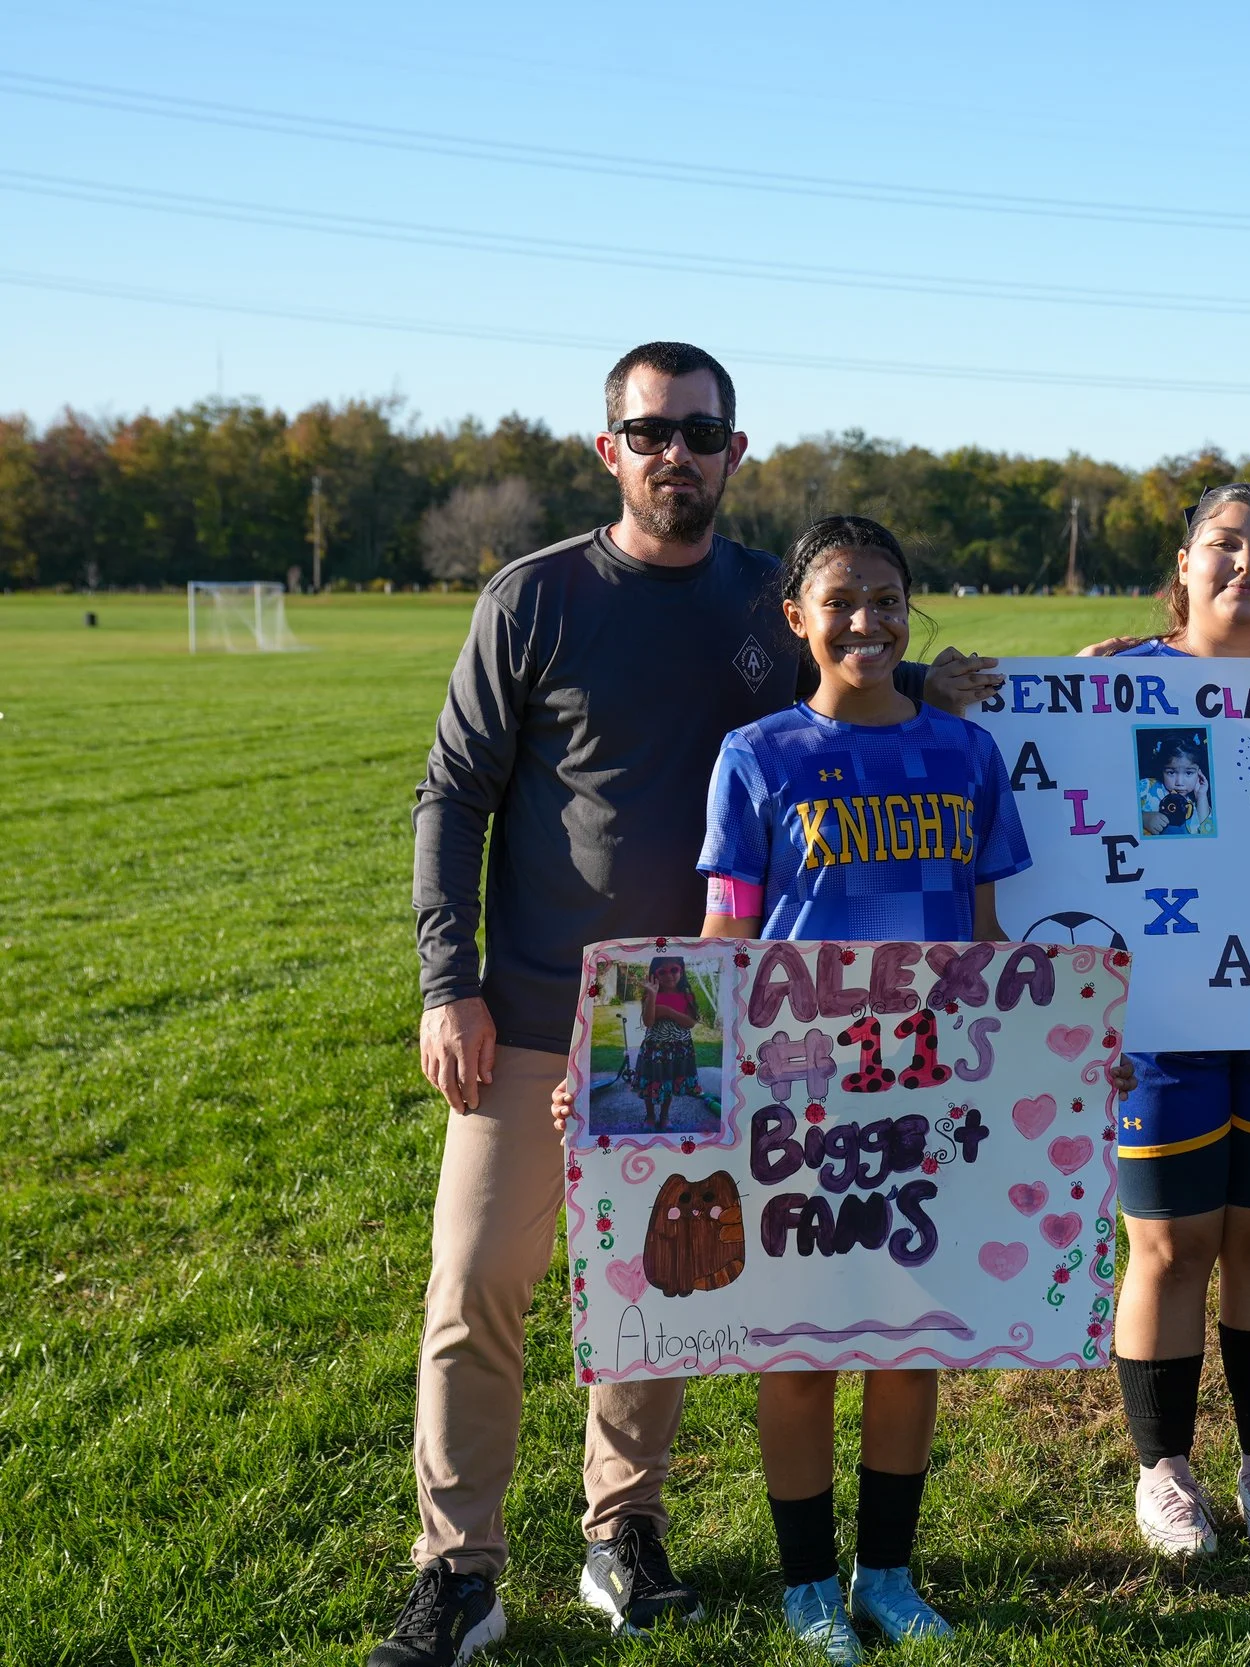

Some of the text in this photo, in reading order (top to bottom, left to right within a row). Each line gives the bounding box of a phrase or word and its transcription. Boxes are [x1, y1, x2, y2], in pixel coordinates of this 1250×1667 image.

[981, 673, 1179, 715] SENIOR
[796, 792, 975, 871] KNIGHTS
[748, 941, 1056, 1029] ALEXA
[616, 1304, 749, 1373] Autograph?
